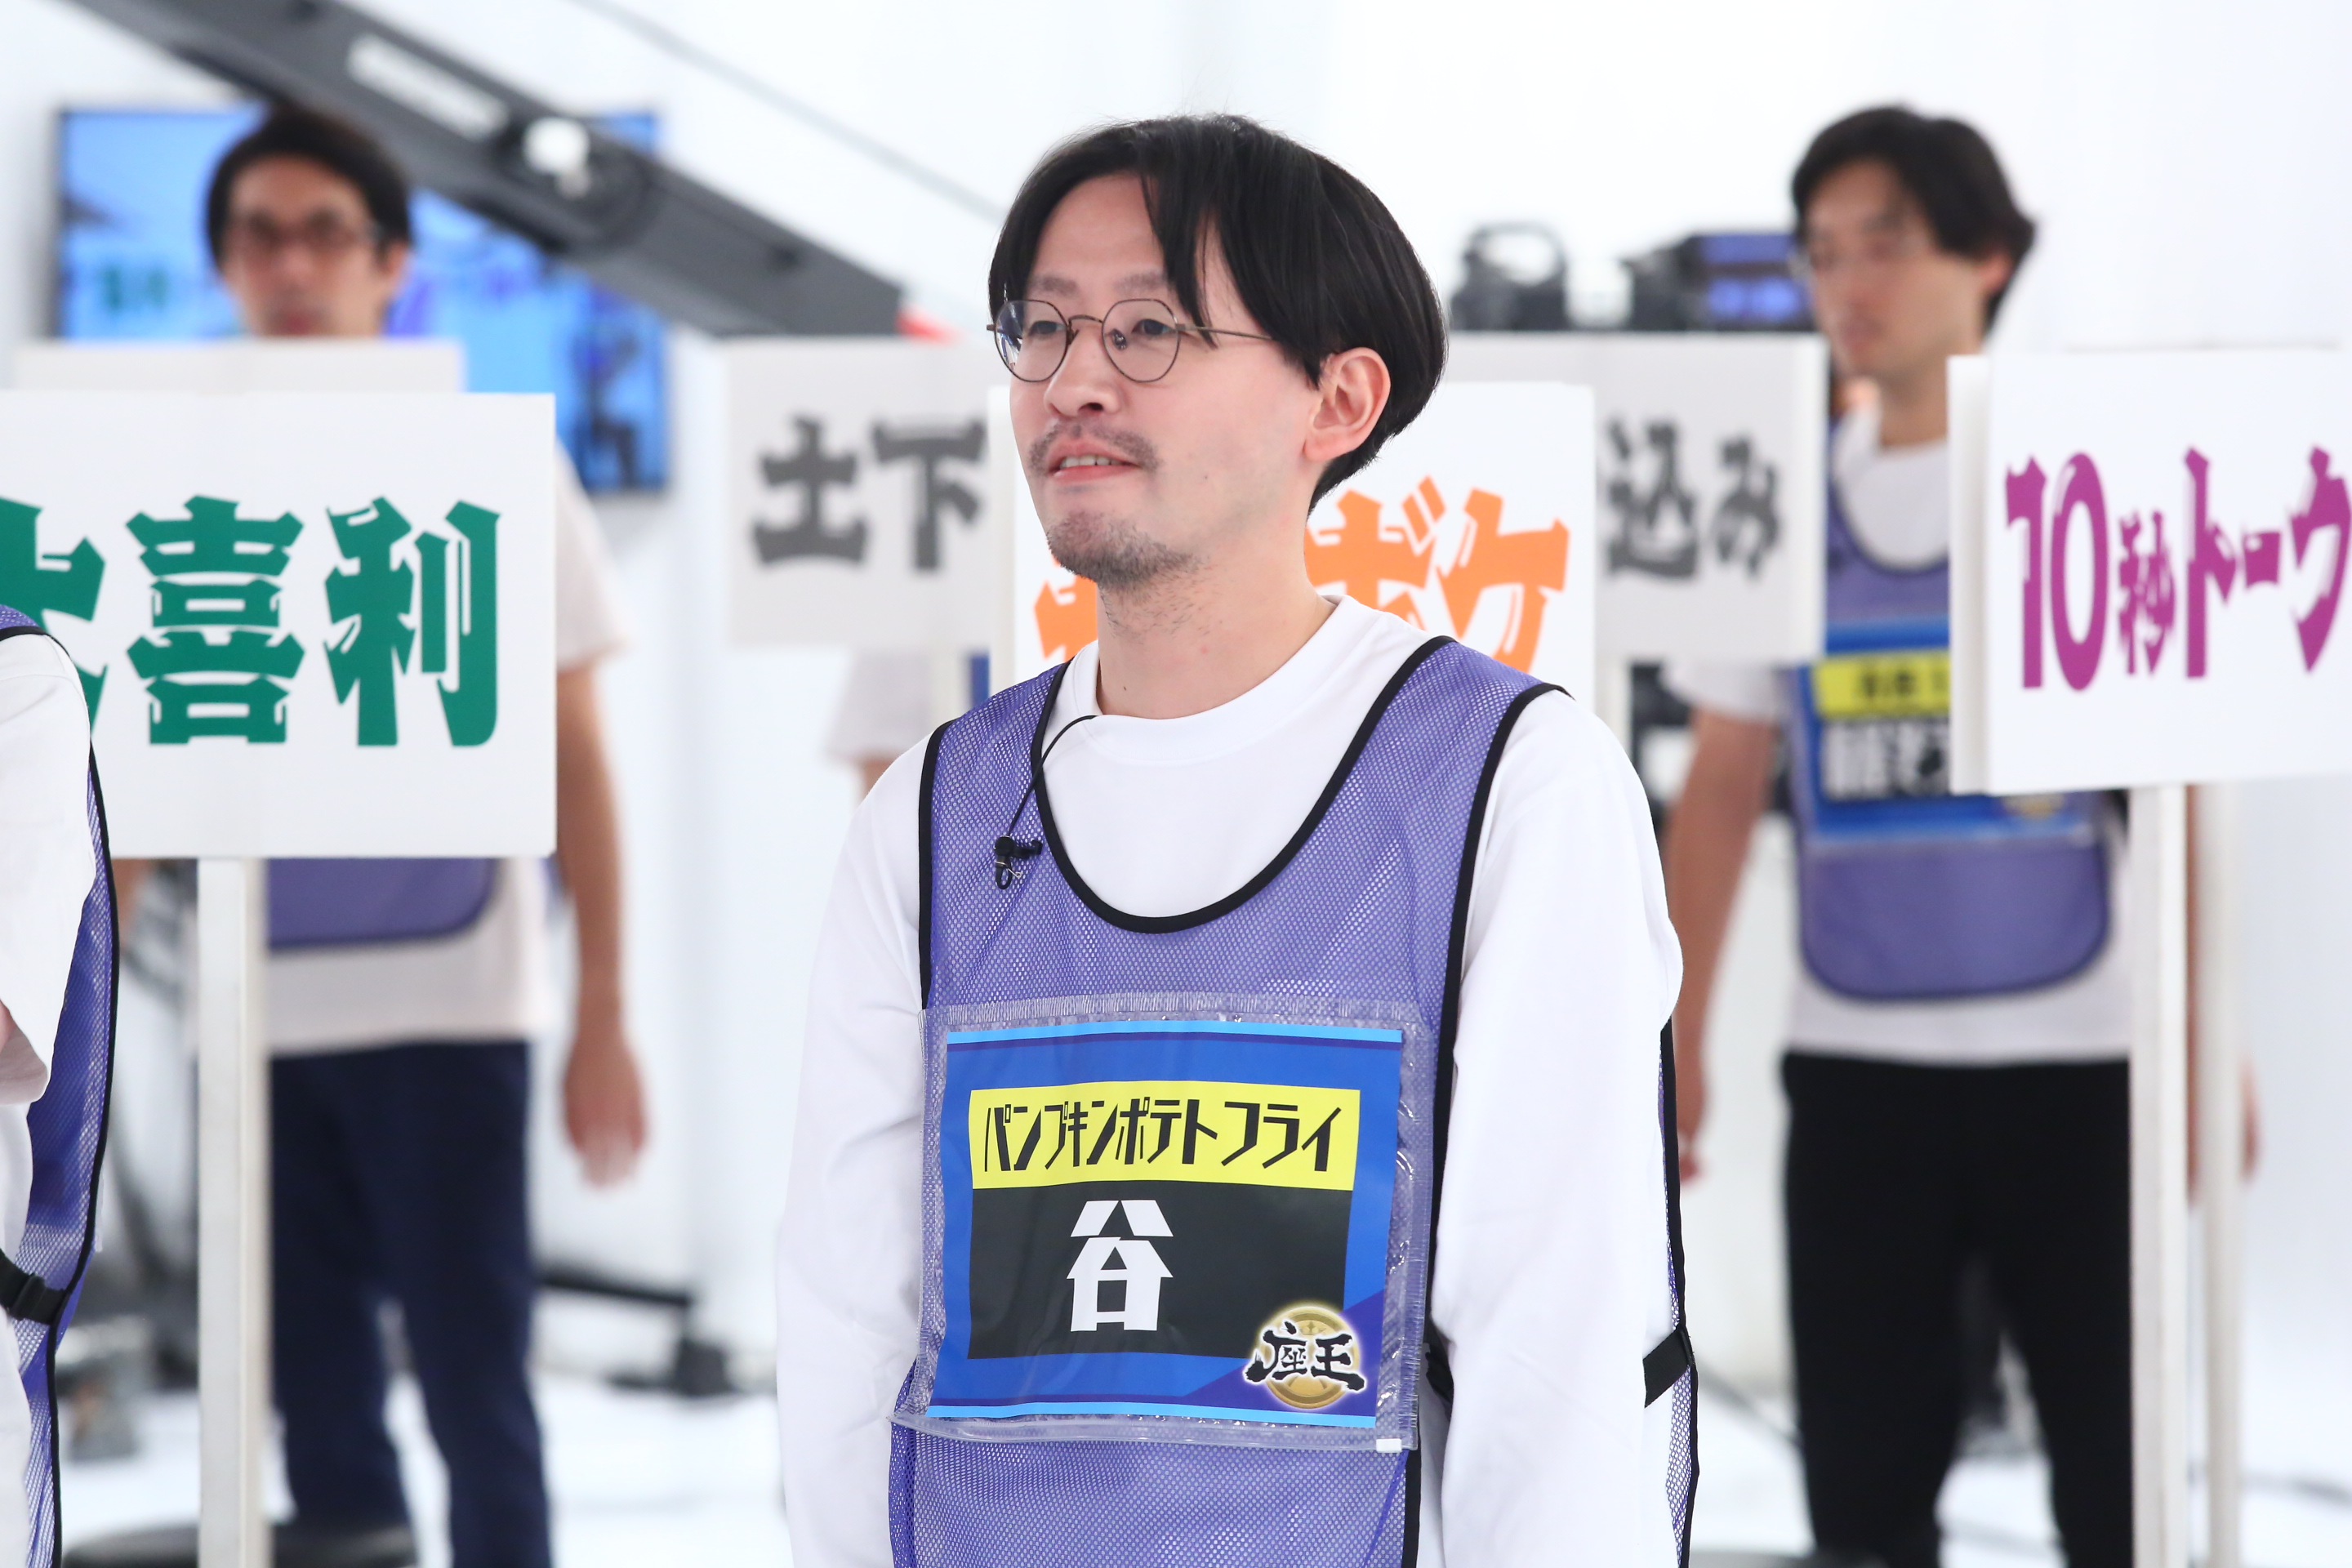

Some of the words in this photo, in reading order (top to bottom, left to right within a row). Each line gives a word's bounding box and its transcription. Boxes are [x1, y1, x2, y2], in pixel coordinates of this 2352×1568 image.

[2004, 445, 2352, 693] 10秒トーク
[984, 1096, 1342, 1173] パンプキンポテトフライ
[1066, 1199, 1174, 1332] 谷
[1245, 1321, 1366, 1392] 座王
